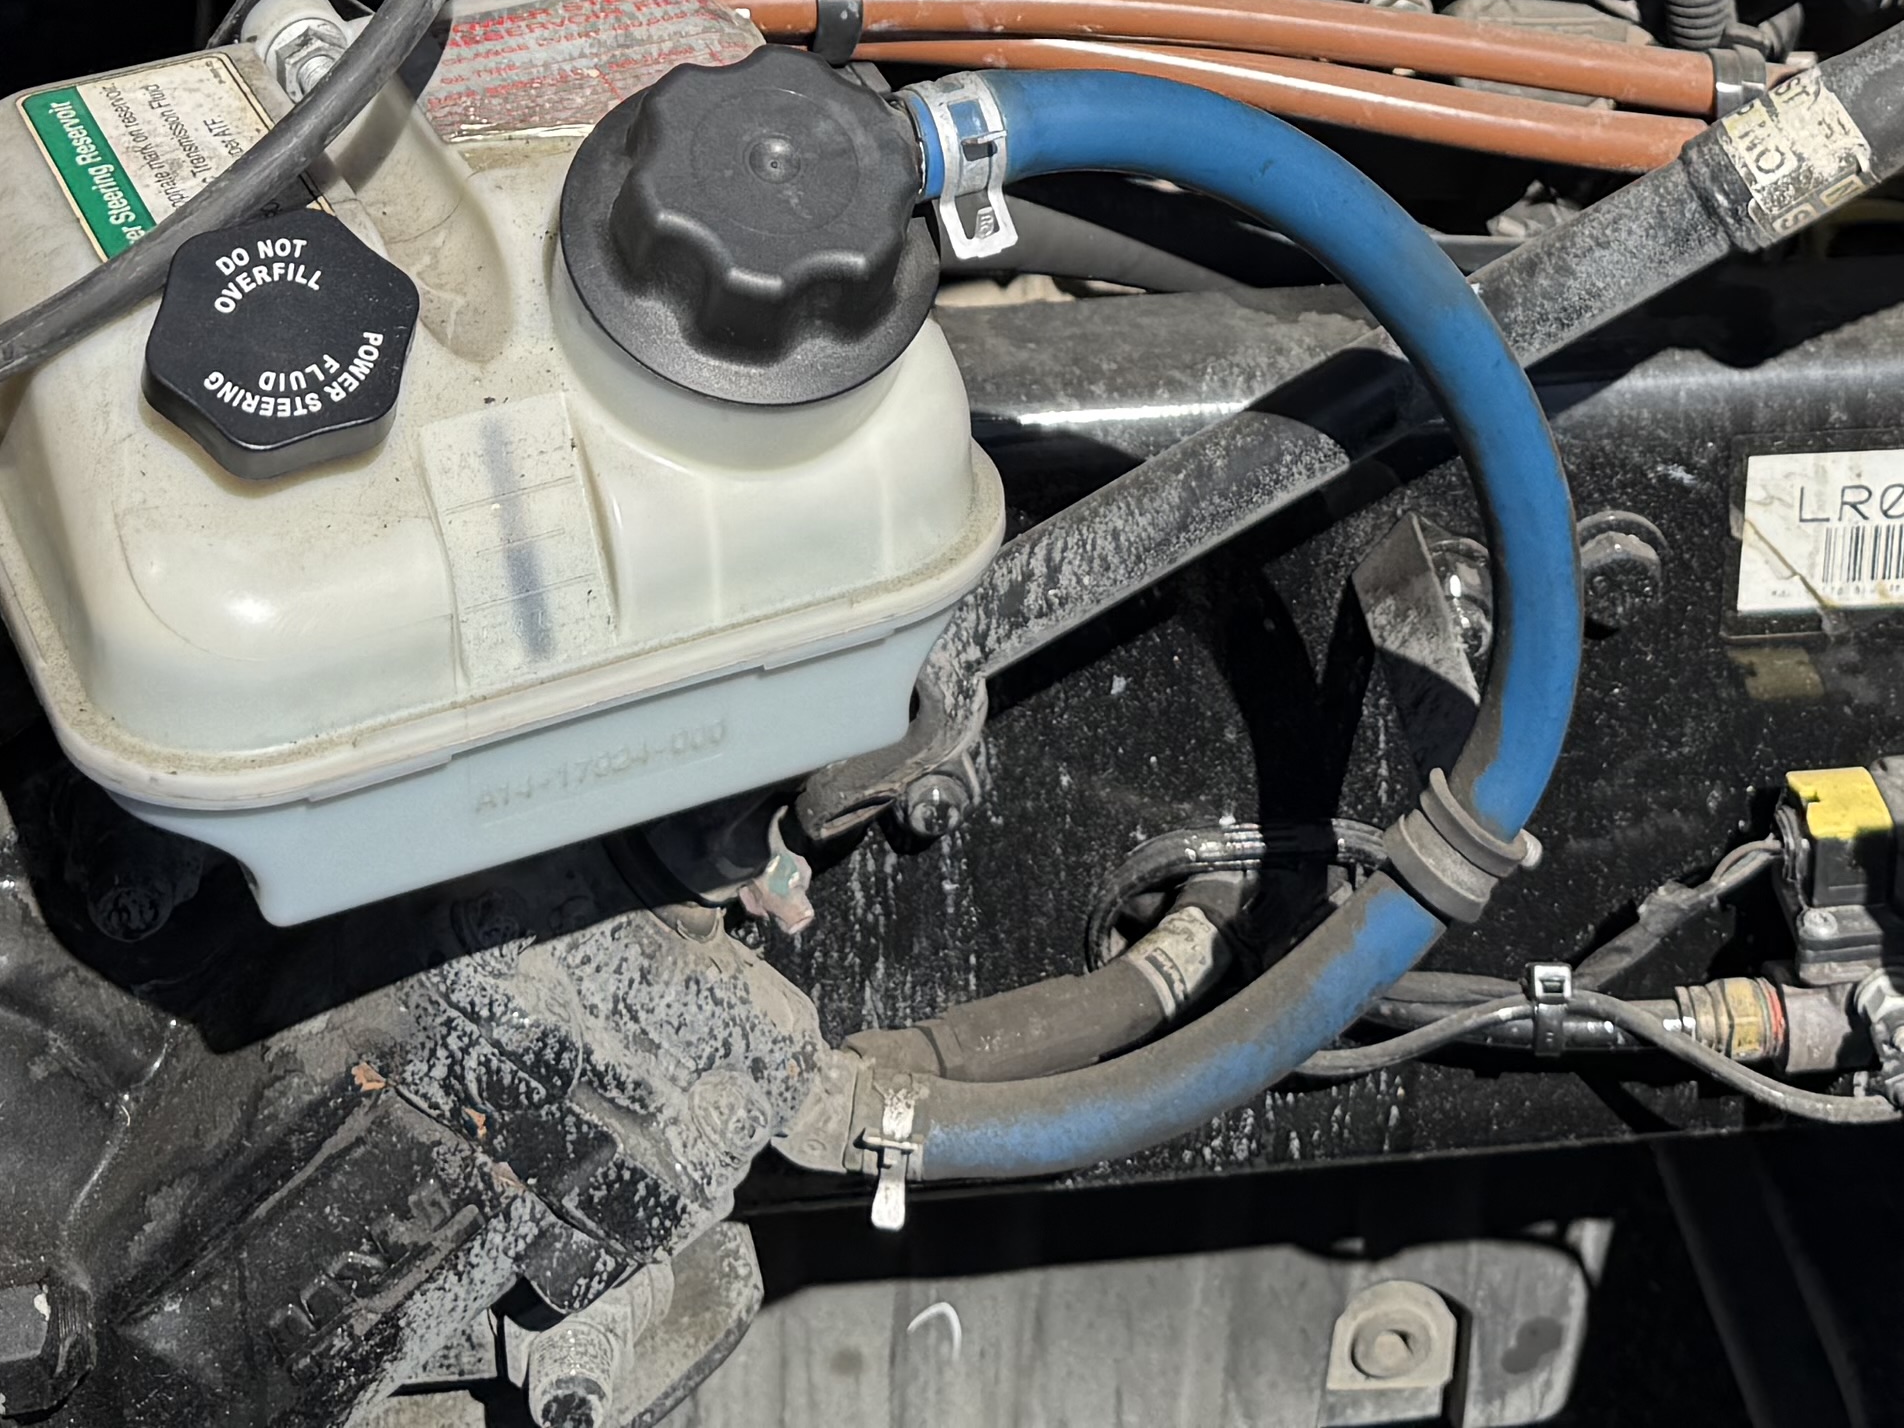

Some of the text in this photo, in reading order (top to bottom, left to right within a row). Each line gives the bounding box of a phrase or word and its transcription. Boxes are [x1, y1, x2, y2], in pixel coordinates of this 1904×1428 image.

[48, 100, 137, 226] Steering Reservoir
[141, 83, 211, 178] Transmission Fluid
[214, 262, 322, 314] OVERFILL
[215, 238, 308, 276] DO NOT
[203, 331, 384, 418] POWER STEERING
[258, 354, 341, 392] FLUID
